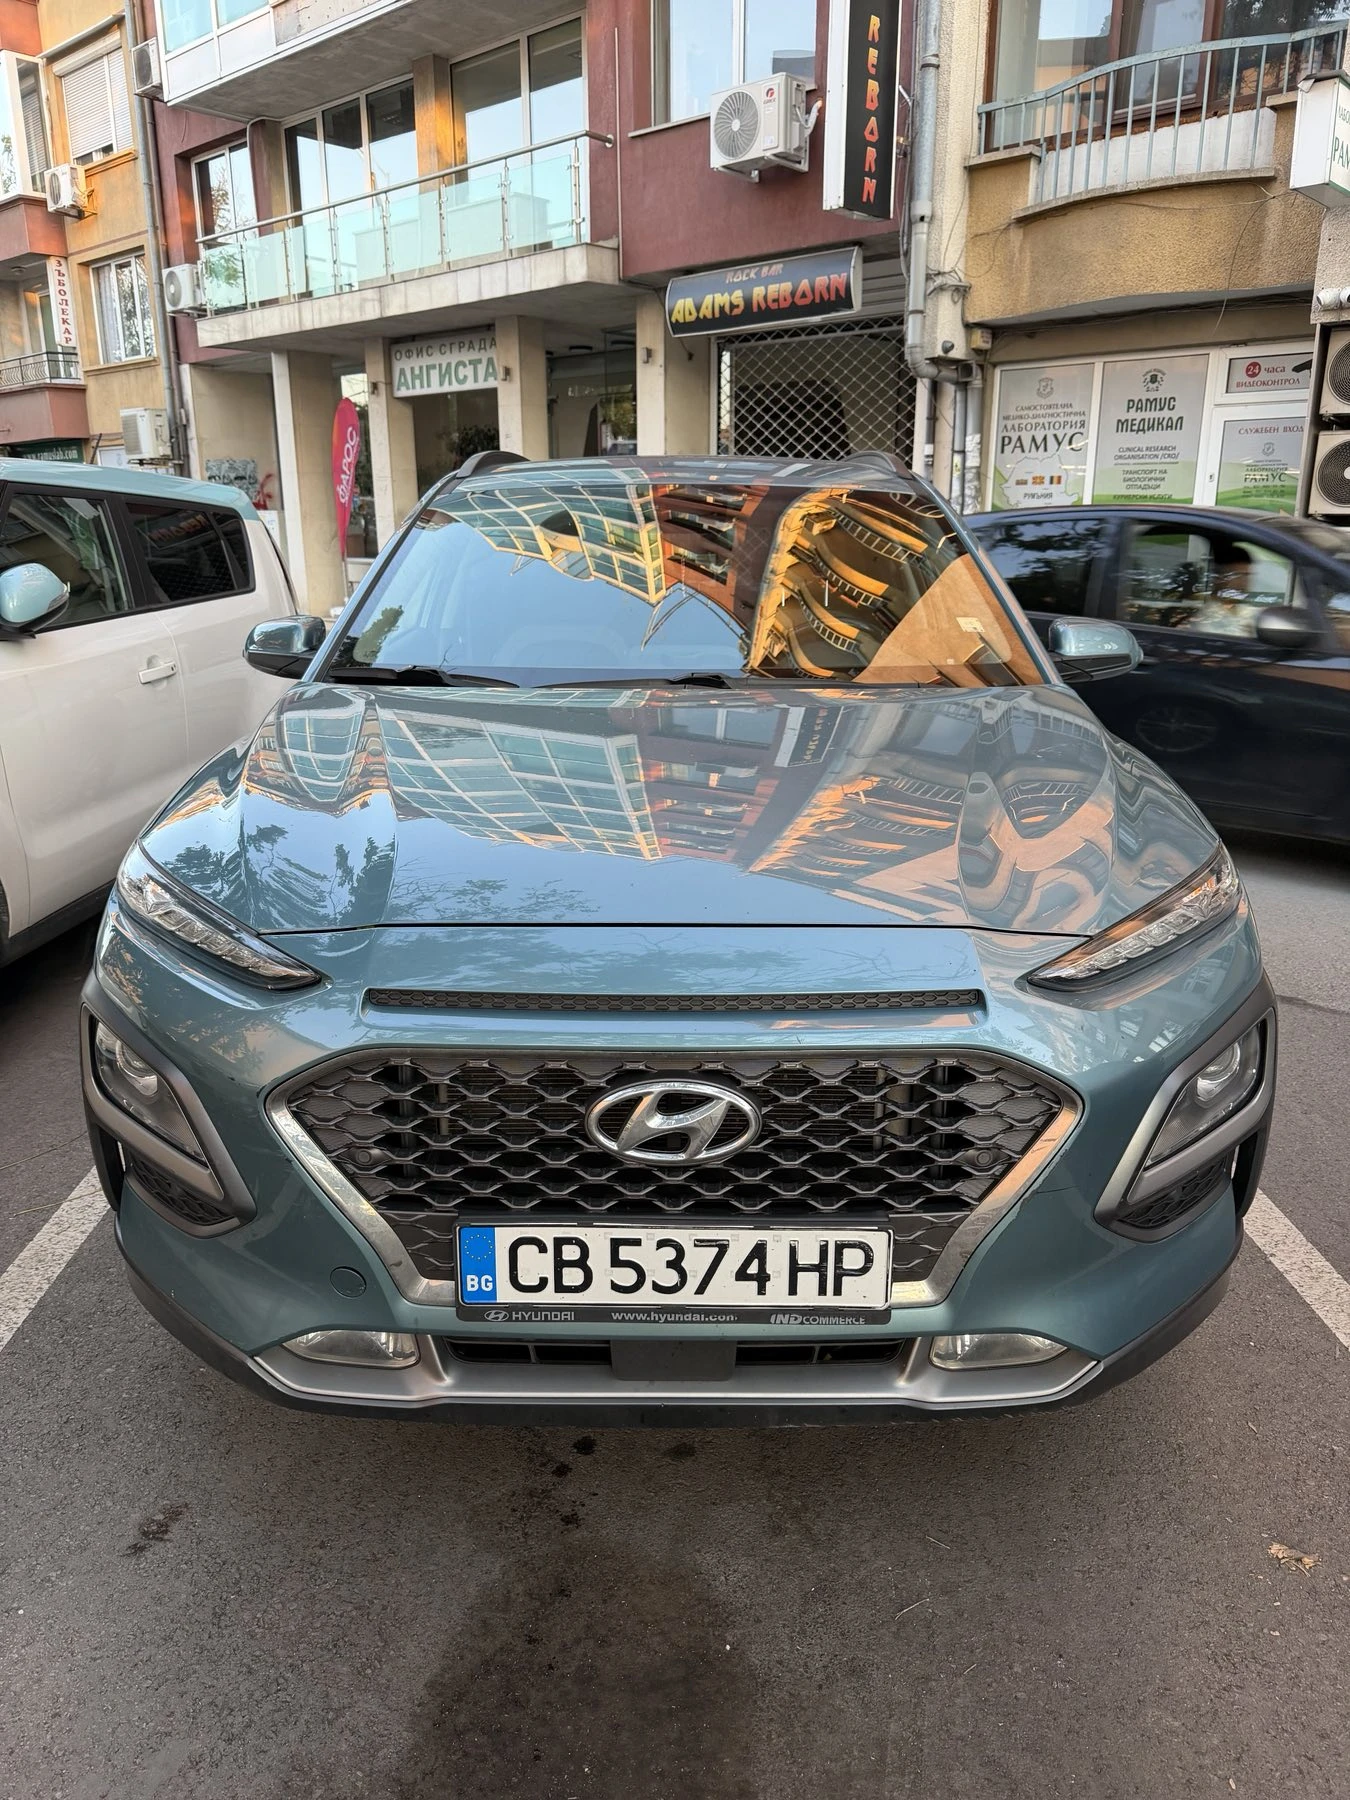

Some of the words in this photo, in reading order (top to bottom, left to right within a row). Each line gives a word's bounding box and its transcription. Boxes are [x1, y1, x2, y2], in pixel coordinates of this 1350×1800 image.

[862, 14, 881, 205] REBORN
[725, 268, 758, 284] ROCK
[760, 263, 784, 278] BAR
[55, 259, 73, 345] ЗЪБОЛЕКАР
[671, 289, 745, 324] ADAMS
[752, 272, 848, 313] REBORN
[394, 345, 434, 361] ОФИС
[439, 337, 497, 355] СГРАДА
[396, 357, 498, 391] АНГИСТА
[1248, 365, 1260, 375] 24
[1264, 365, 1286, 374] часа
[1236, 377, 1300, 388] ВИДЕОКОНТРОЛ
[1126, 396, 1177, 413] РАМУС
[1001, 420, 1086, 433] ЛАБОРАТОРИЯ
[1116, 416, 1184, 434] МЕДИКАЛ
[1238, 427, 1279, 435] СЛУЖЕБЕН
[1283, 425, 1304, 433] ВХОД
[1000, 432, 1084, 454] РАМУС
[508, 1236, 593, 1294] CB
[609, 1238, 772, 1296] 5374
[788, 1239, 875, 1297] HP
[467, 1274, 494, 1292] BG
[512, 1311, 575, 1321] HYUNDAI
